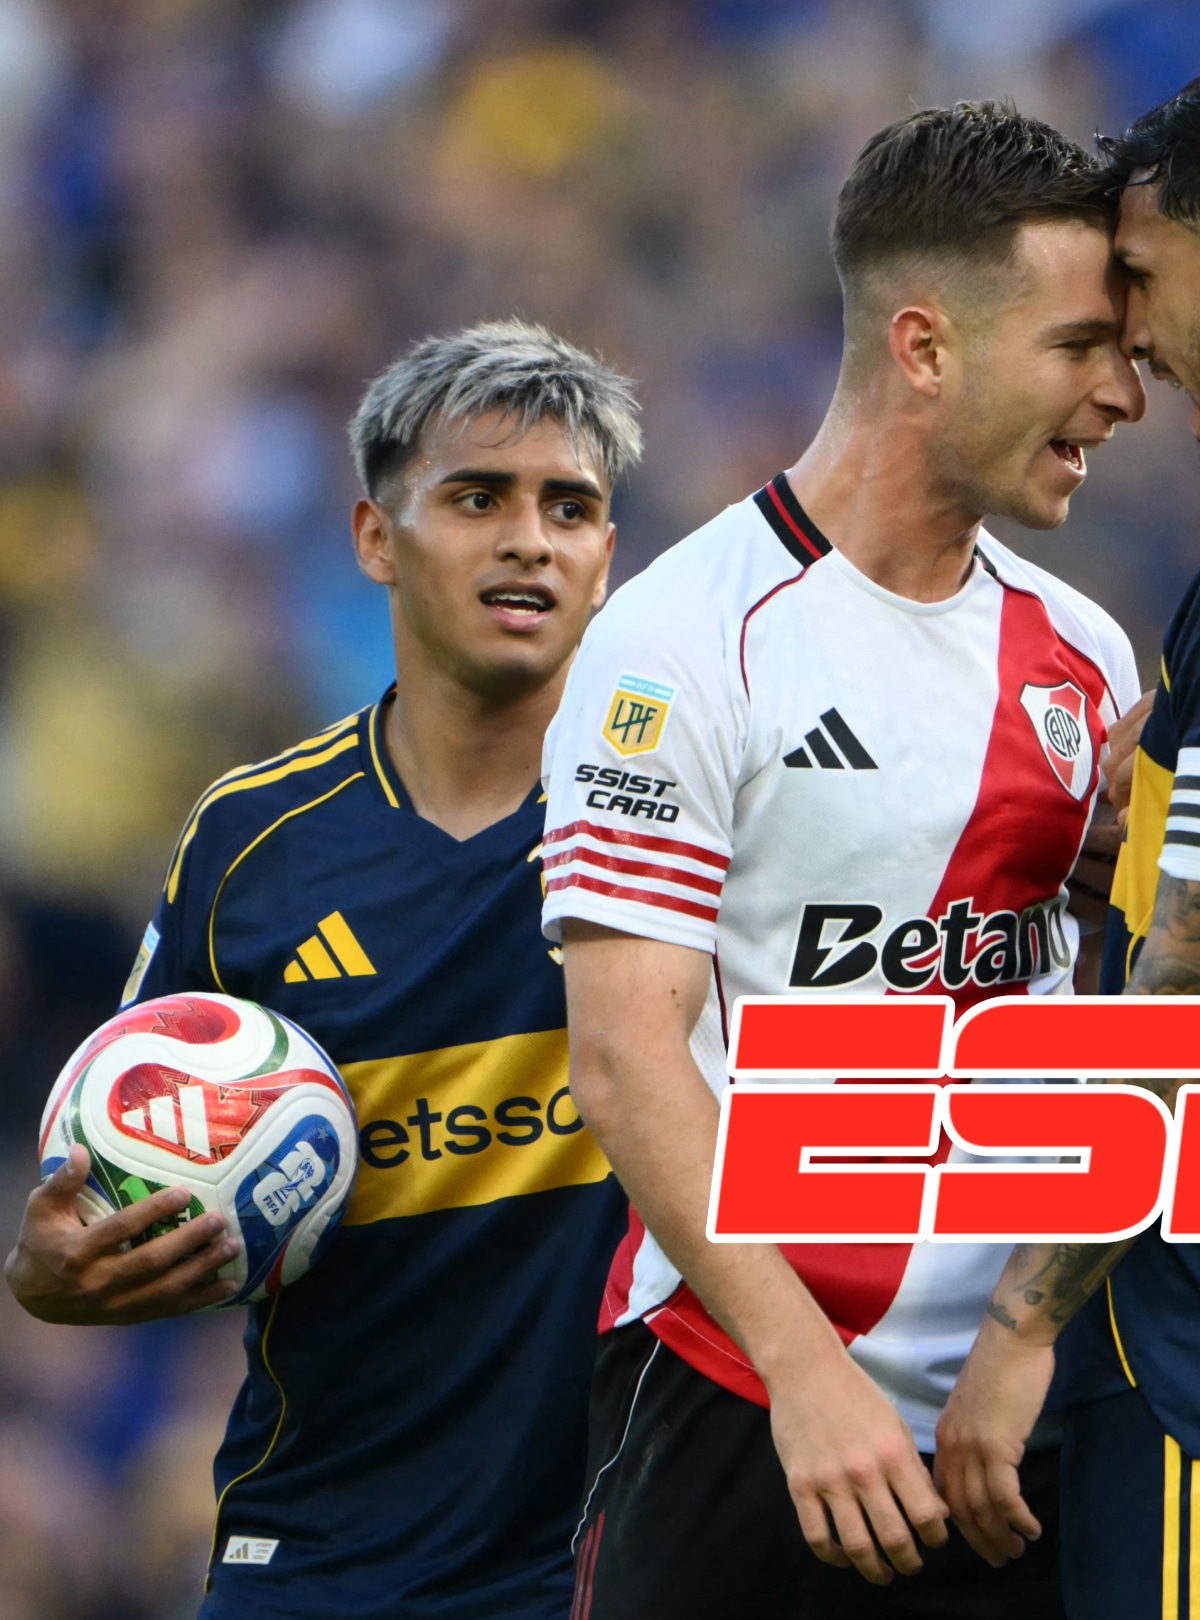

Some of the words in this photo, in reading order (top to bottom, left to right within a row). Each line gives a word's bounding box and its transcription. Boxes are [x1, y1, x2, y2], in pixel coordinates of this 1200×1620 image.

[586, 789, 680, 823] CARD
[787, 897, 1071, 992] Betano
[262, 1194, 280, 1216] FIFA
